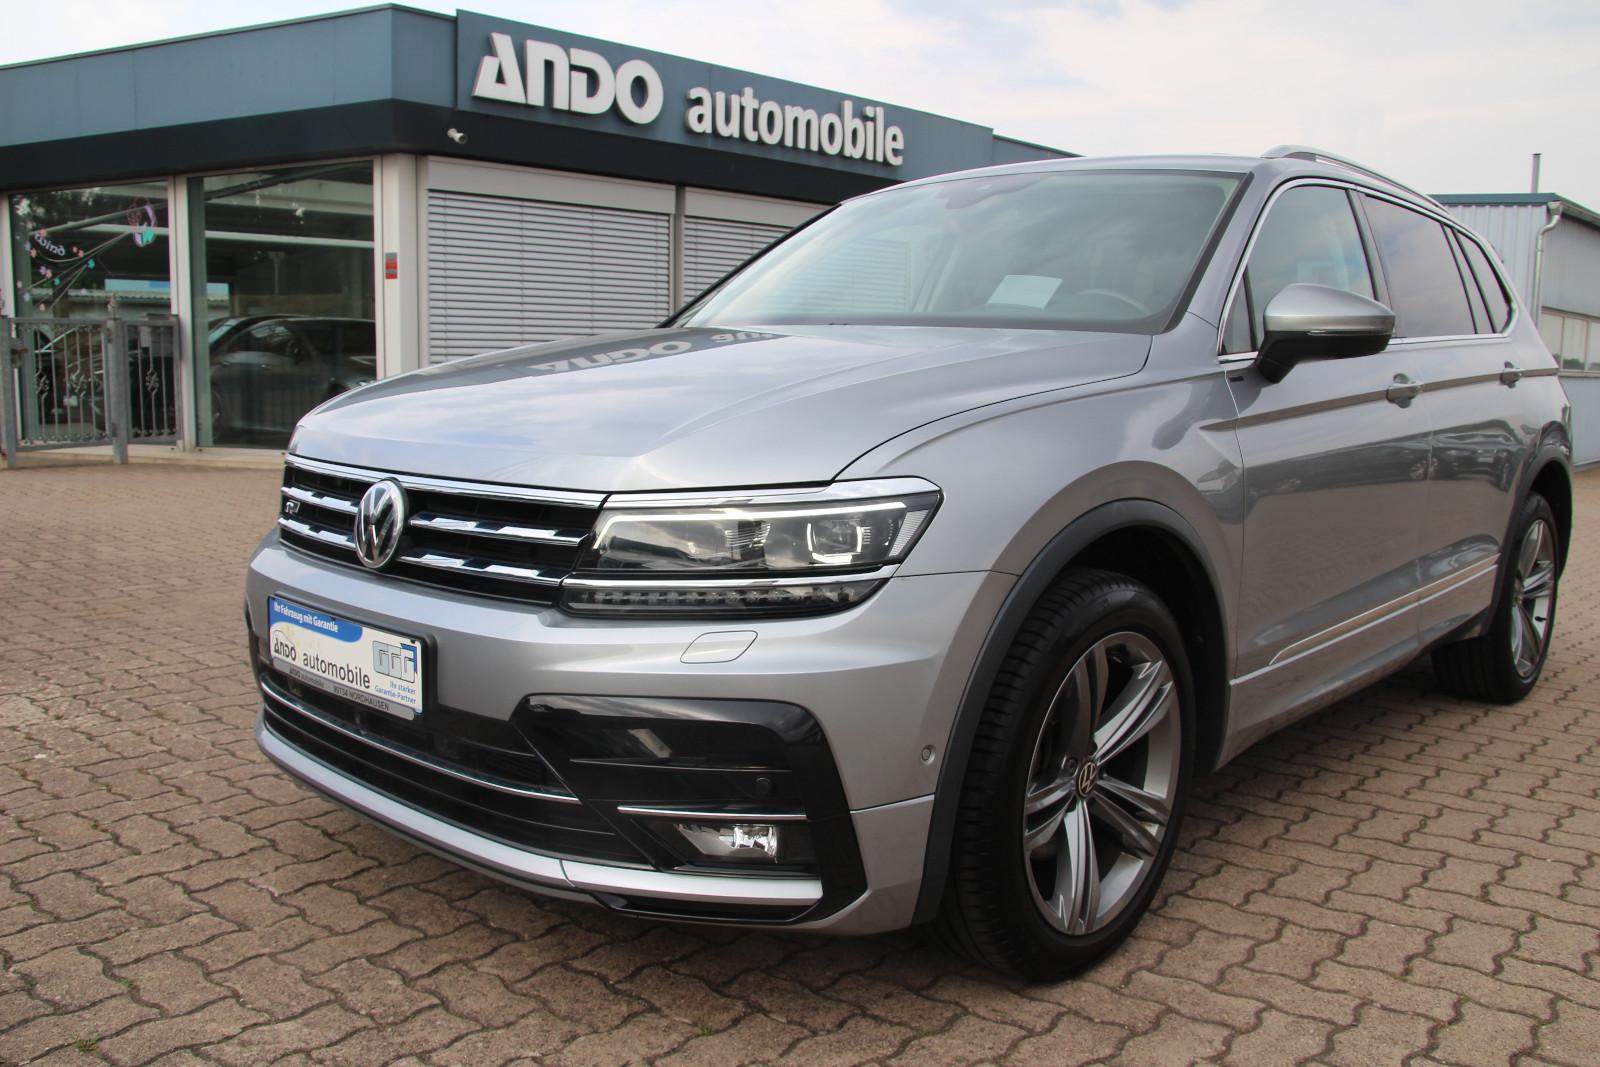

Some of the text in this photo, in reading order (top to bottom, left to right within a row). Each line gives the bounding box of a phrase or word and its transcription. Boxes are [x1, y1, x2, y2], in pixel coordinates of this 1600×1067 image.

[471, 31, 905, 167] ANDO automobile
[280, 605, 303, 623] Fahrzeug
[303, 614, 313, 625] mit
[313, 616, 338, 632] Garantie
[274, 638, 370, 689] ANDO automobile
